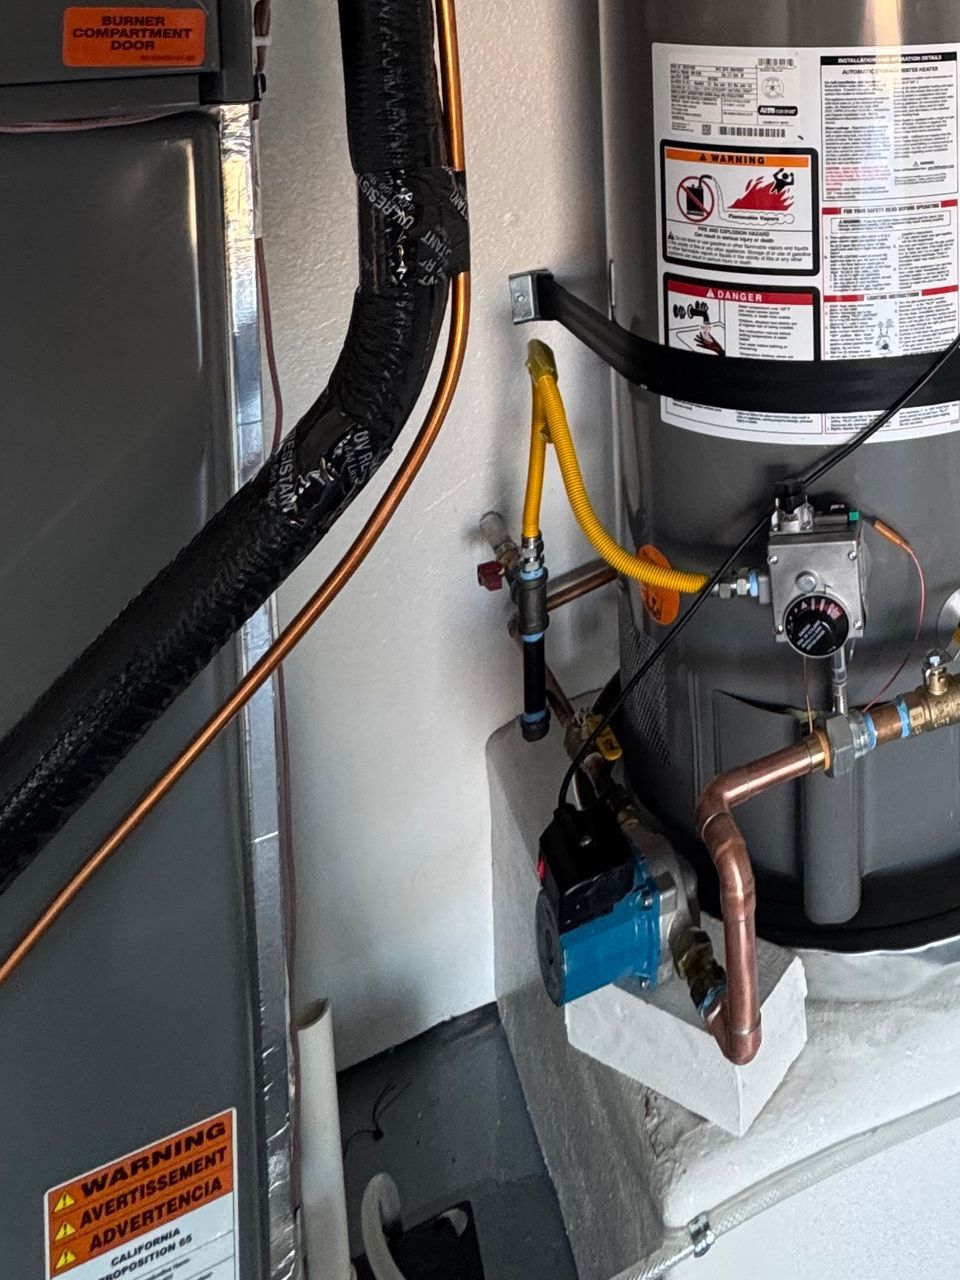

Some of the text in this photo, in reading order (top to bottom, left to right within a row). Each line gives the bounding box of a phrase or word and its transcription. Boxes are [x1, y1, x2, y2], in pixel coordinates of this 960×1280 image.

[101, 15, 166, 26] BURNER
[72, 28, 193, 39] COMPARTMENT
[110, 40, 156, 51] DOOR
[711, 154, 765, 164] WARNING
[717, 290, 762, 302] DANGER
[80, 1122, 227, 1198] WARNING
[79, 1146, 228, 1229] AVERTISSEMENT
[89, 1177, 223, 1253] ADVERTENCIA
[110, 1227, 181, 1267] CALIFORNIA
[178, 1234, 193, 1249] 65
